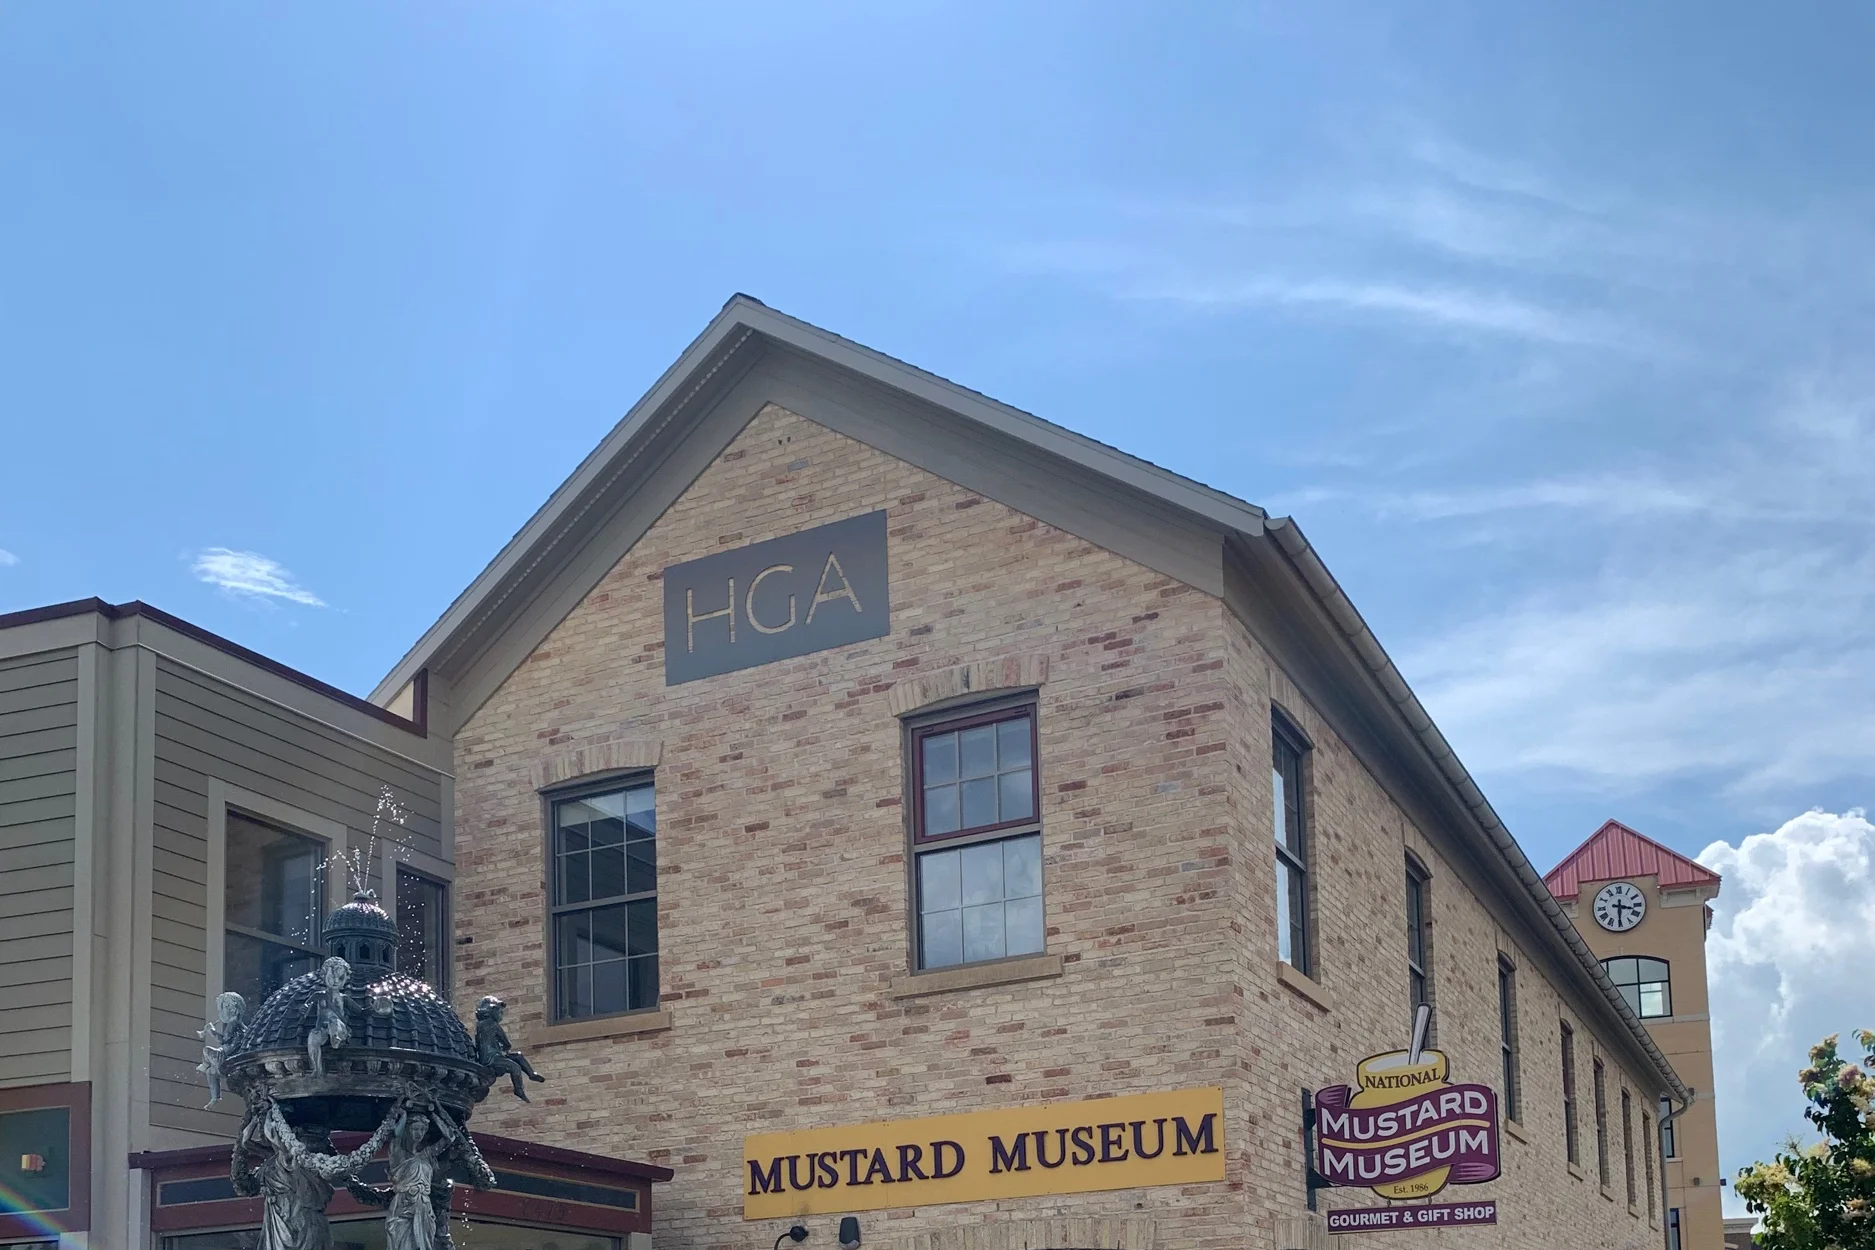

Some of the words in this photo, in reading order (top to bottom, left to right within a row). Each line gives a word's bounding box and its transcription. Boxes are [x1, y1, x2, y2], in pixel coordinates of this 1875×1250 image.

[686, 551, 863, 653] HGA
[1365, 1068, 1441, 1089] NATIONAL
[1321, 1090, 1488, 1140] MUSTARD
[747, 1140, 965, 1195] MUSTARD
[988, 1113, 1219, 1173] MUSEUM
[1323, 1130, 1489, 1180] MUSEUM
[1393, 1185, 1408, 1195] Est.
[1410, 1183, 1429, 1193] 1986
[1329, 1211, 1399, 1227] GOURMET
[1403, 1210, 1414, 1223] &
[1417, 1208, 1450, 1222] GIFT
[1454, 1206, 1494, 1220] SHOP
